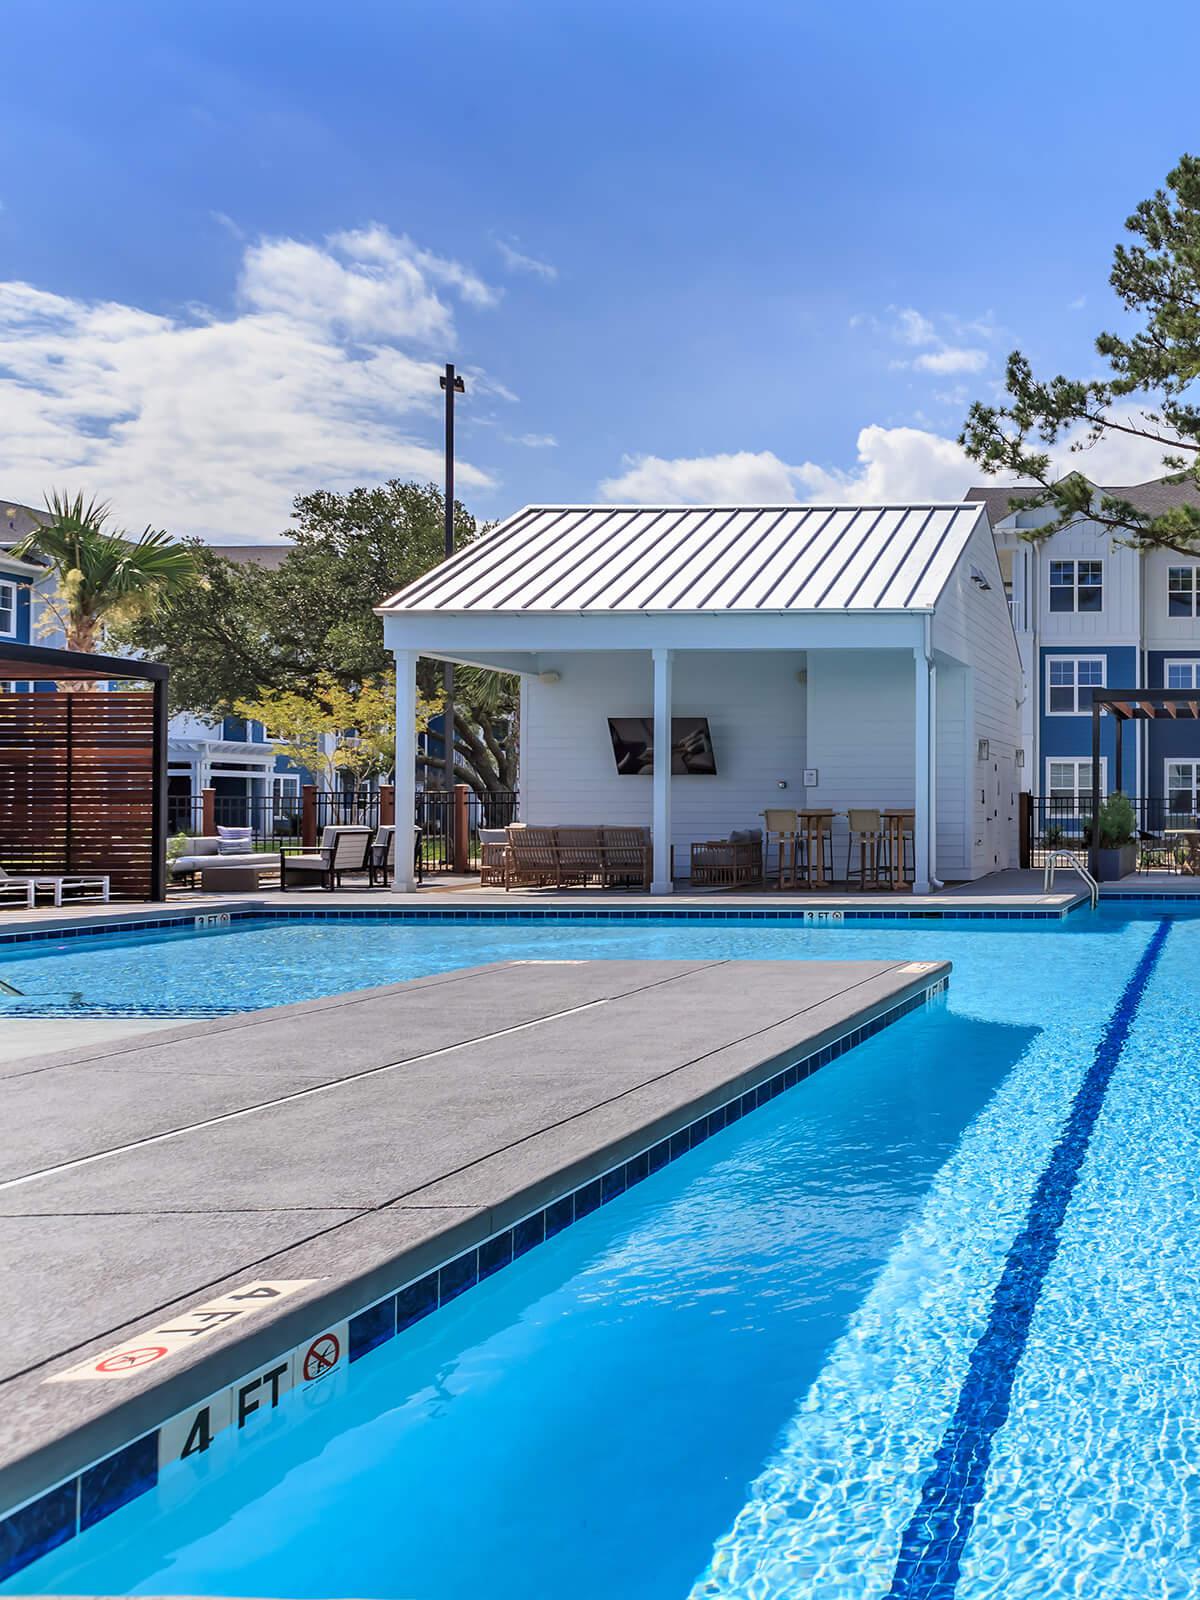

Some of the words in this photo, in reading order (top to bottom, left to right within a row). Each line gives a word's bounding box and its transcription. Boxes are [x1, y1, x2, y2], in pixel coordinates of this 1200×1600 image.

[818, 911, 830, 920] FT
[228, 1287, 281, 1301] 4
[156, 1311, 245, 1337] FT
[180, 1406, 215, 1461] 4
[237, 1362, 289, 1430] FT
